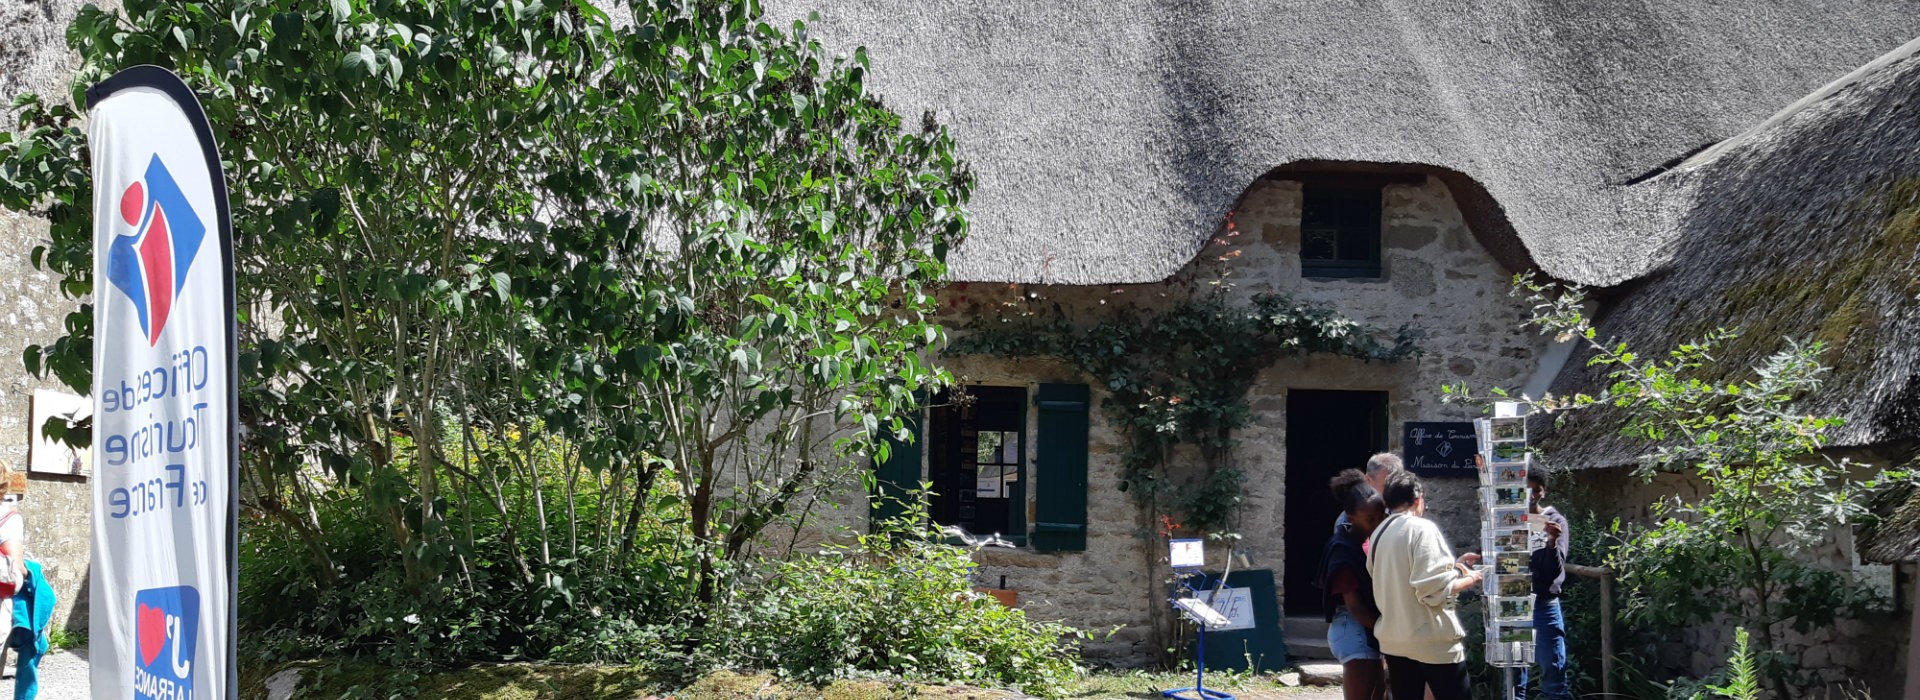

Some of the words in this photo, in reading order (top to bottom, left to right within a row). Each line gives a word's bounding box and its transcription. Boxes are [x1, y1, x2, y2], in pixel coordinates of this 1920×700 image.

[1409, 427, 1432, 446] Office
[1434, 432, 1443, 440] de
[1447, 429, 1477, 439] Tourism
[1463, 458, 1478, 469] Par
